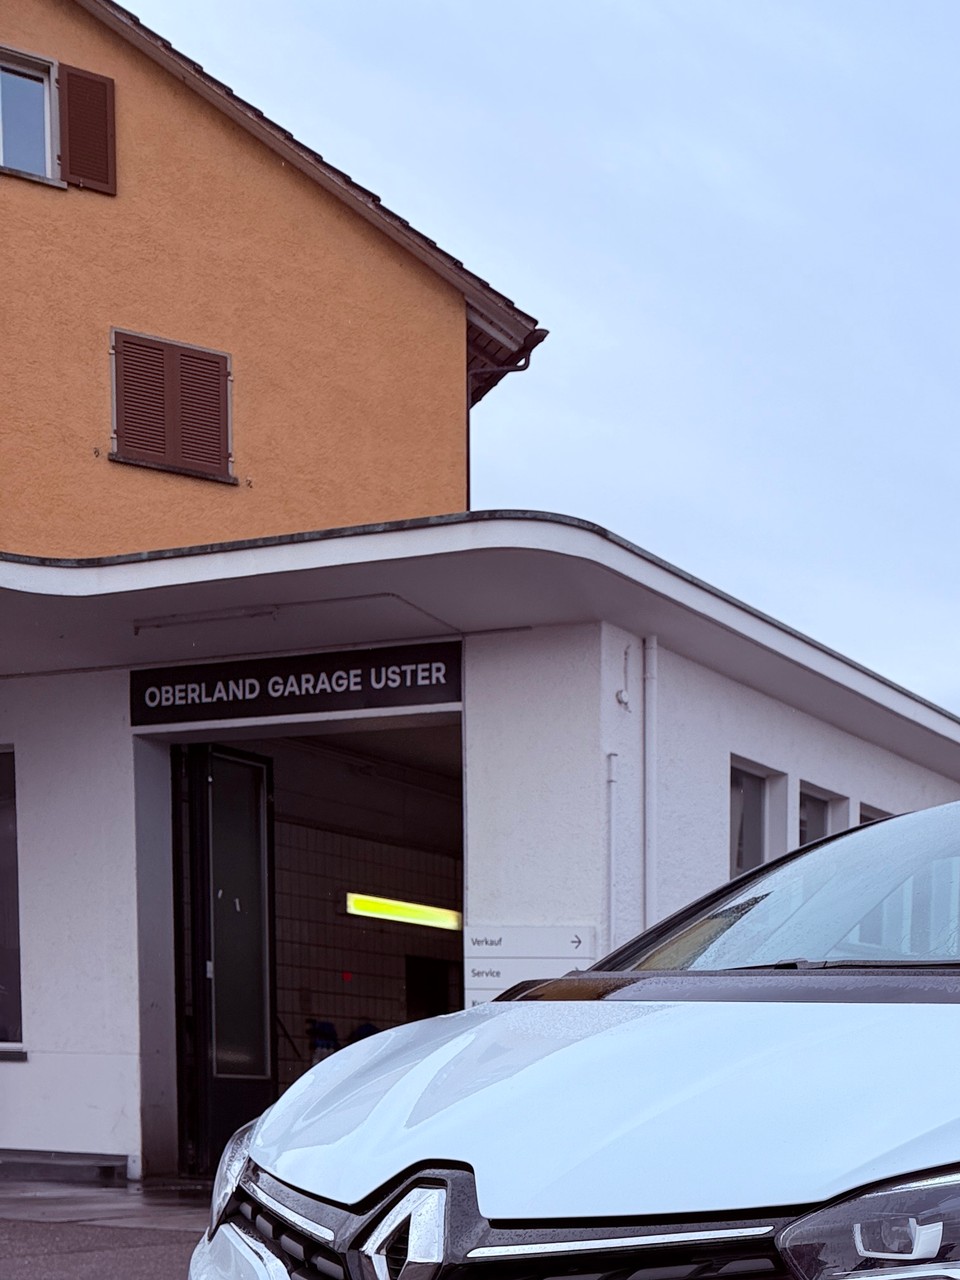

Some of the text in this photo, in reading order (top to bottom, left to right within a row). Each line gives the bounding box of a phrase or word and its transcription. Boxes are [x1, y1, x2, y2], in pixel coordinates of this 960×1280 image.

[144, 662, 447, 707] OBERLAND GARAGE USTER
[470, 937, 503, 947] Verkauf
[470, 968, 501, 978] Service
